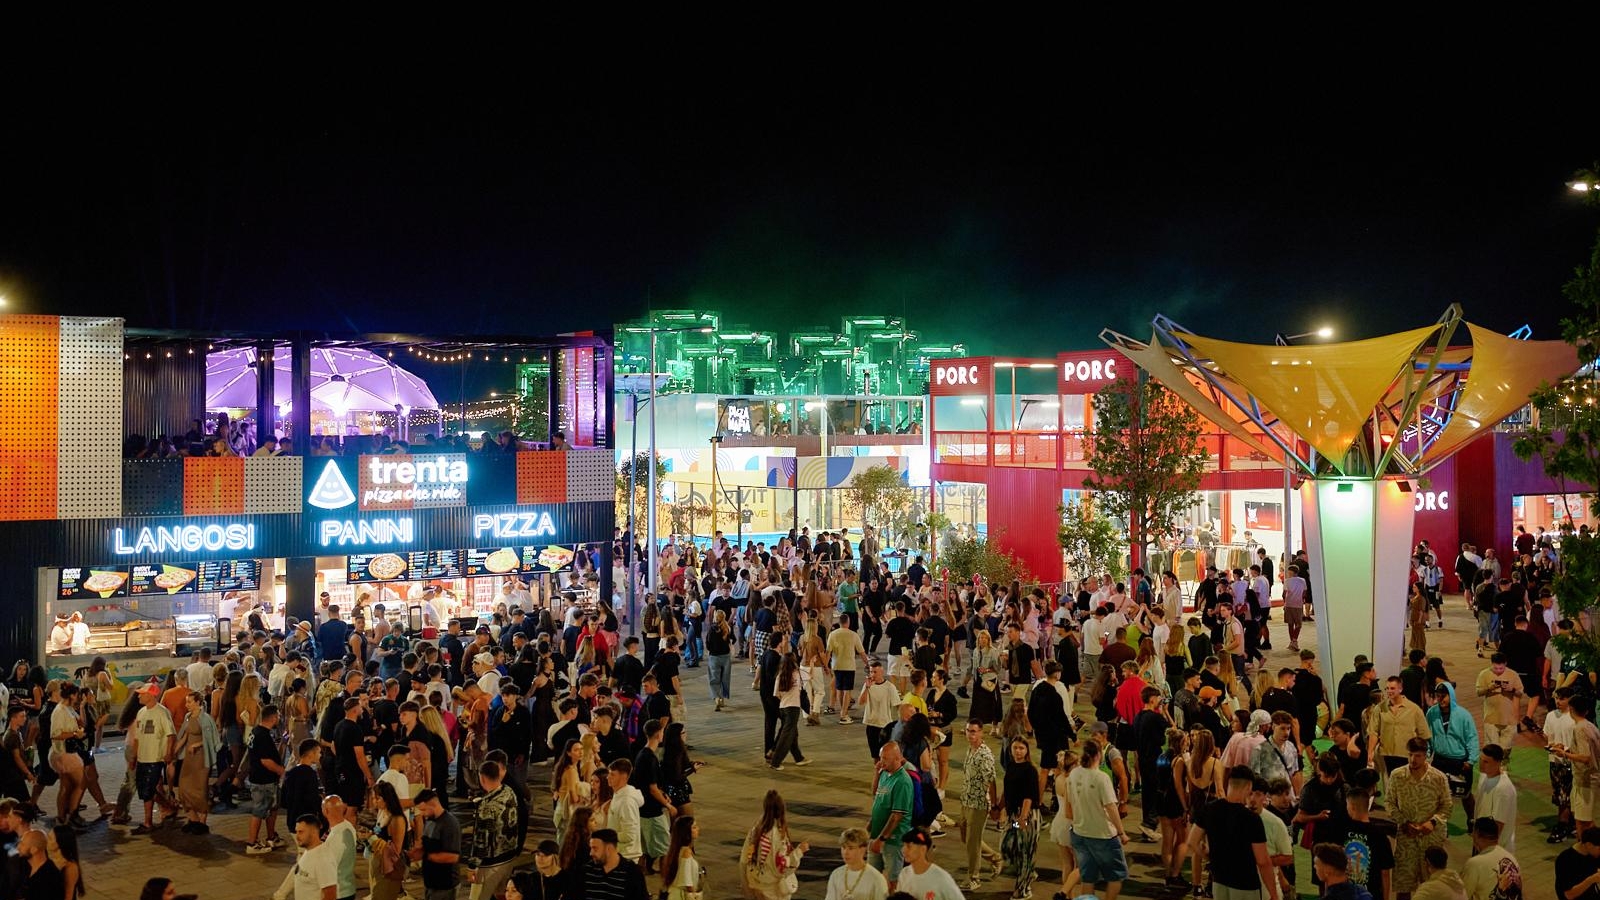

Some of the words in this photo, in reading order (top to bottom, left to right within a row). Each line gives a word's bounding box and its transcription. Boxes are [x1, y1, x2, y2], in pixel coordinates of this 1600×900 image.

[936, 365, 978, 385] PORC
[1065, 359, 1116, 382] PORC
[369, 456, 469, 484] trenta
[363, 486, 403, 506] pizza
[403, 483, 431, 500] che
[431, 483, 462, 499] ride
[710, 489, 767, 505] CRVIT
[1414, 490, 1449, 512] ORC
[321, 518, 413, 546] PANINI
[474, 512, 556, 538] PIZZA
[115, 523, 255, 554] LANGOSI
[1347, 831, 1368, 841] CASA
